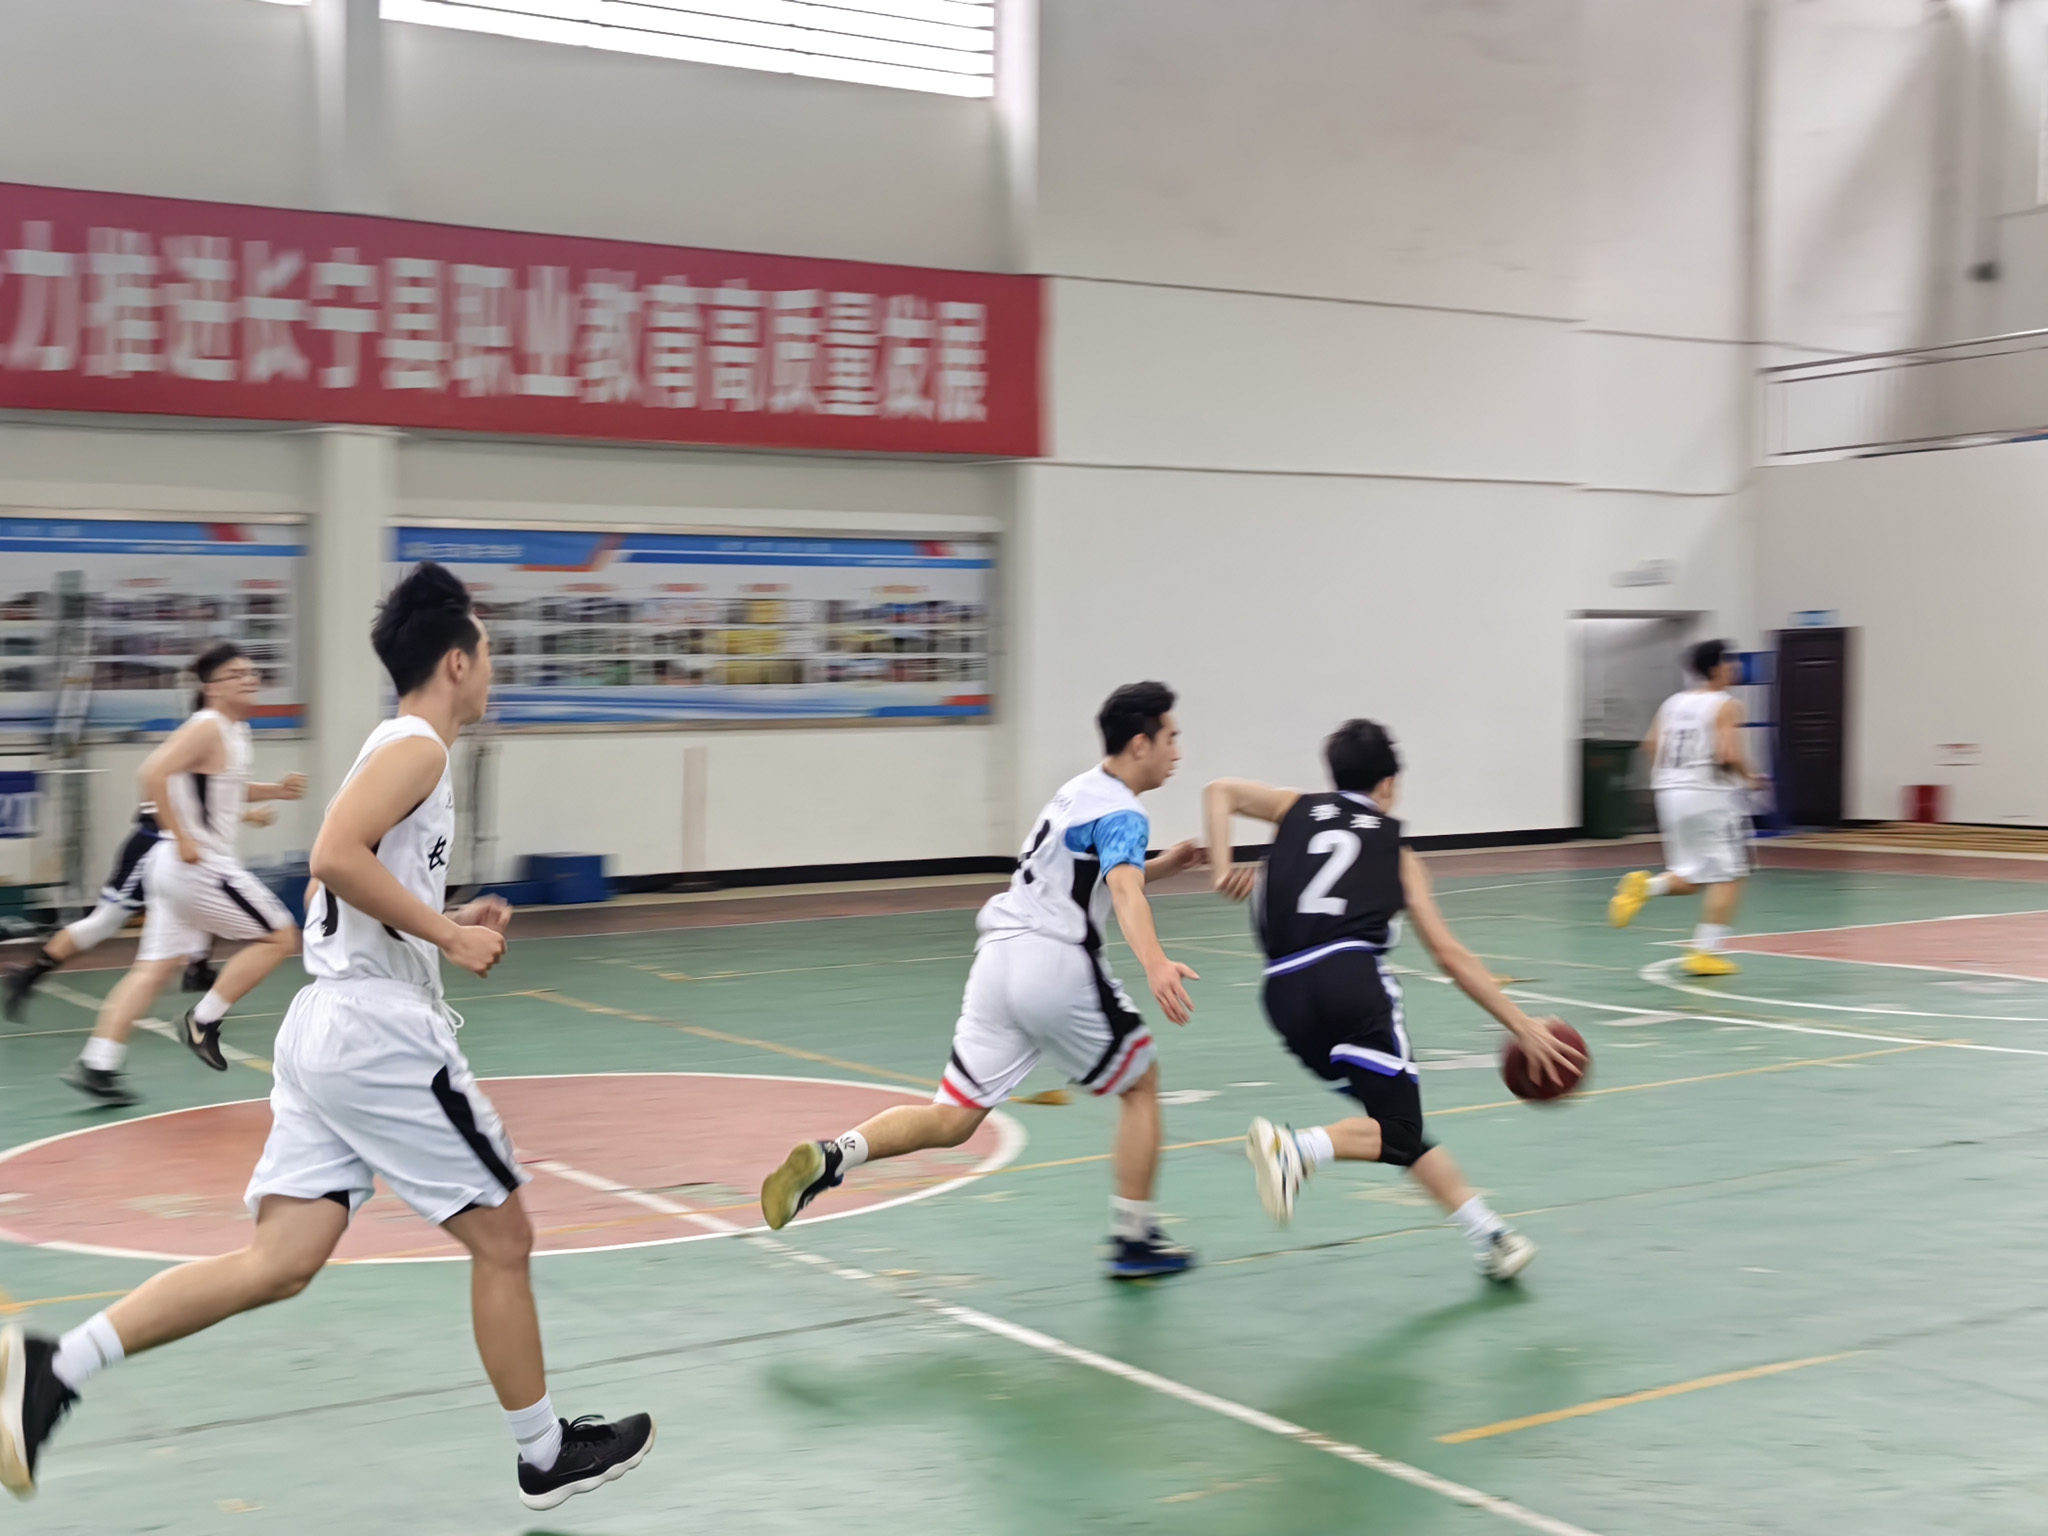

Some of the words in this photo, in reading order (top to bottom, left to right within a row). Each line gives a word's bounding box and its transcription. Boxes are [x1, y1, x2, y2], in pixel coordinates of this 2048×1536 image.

[0, 221, 988, 422] 力推进长宁县职业教育高质量发展
[1296, 829, 1362, 915] 2
